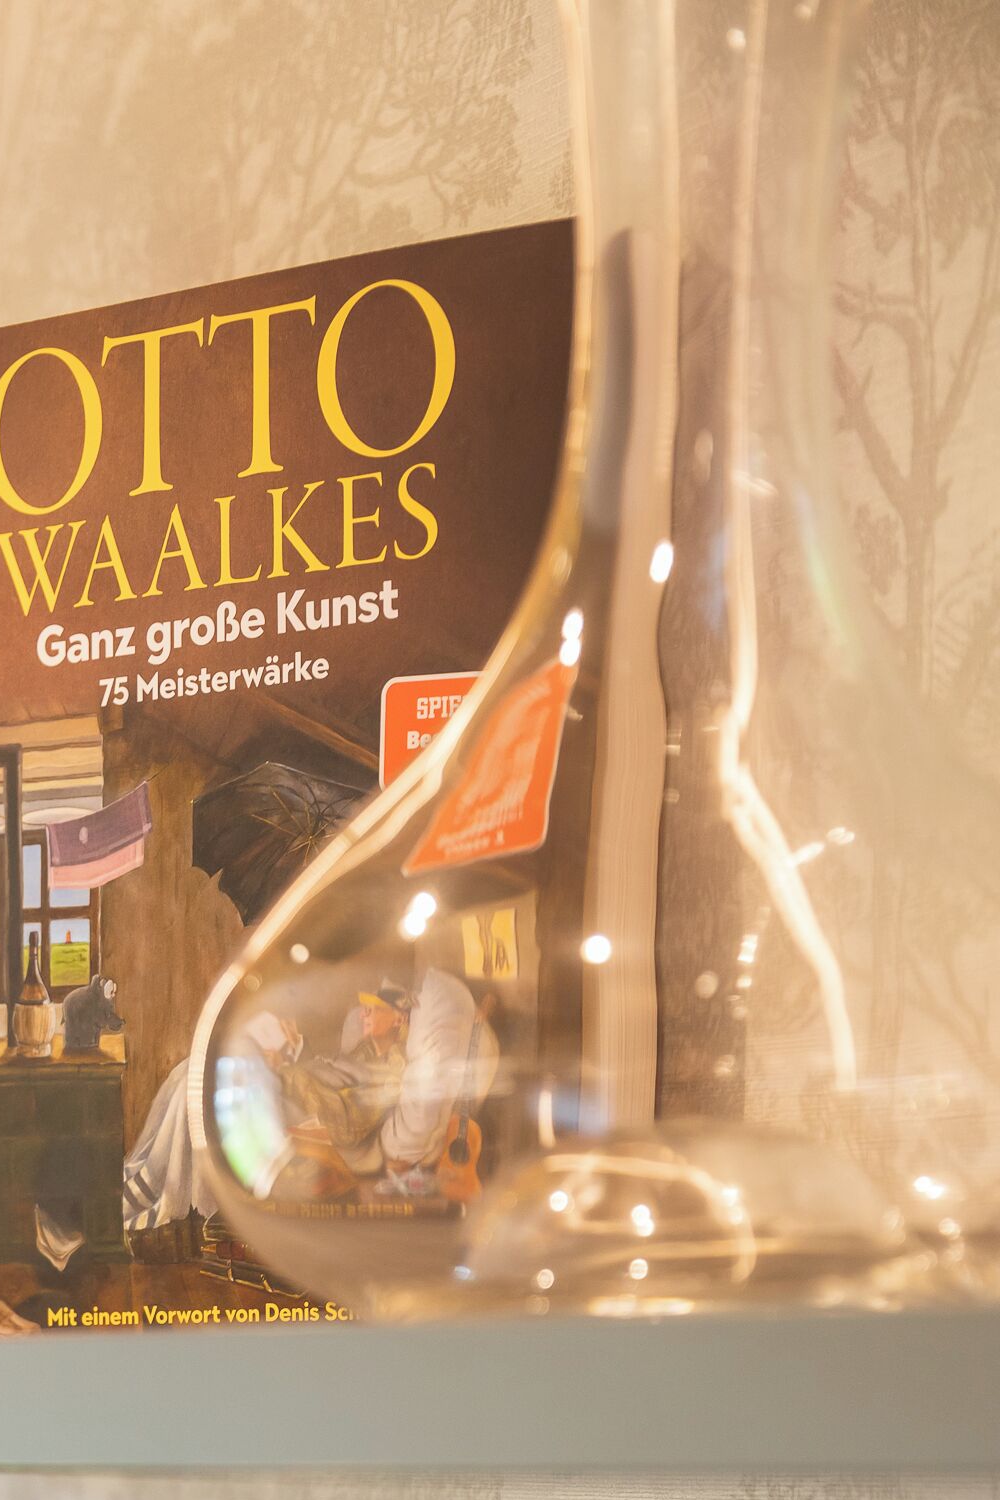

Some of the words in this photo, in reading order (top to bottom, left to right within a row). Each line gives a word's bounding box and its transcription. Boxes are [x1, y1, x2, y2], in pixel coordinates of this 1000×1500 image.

[36, 624, 136, 667] Ganz
[145, 600, 265, 664] große
[276, 579, 399, 634] Kunst
[99, 677, 128, 707] 75
[136, 652, 330, 704] Meisterwärke
[416, 694, 462, 720] SPIE
[47, 1307, 78, 1327] Mit
[81, 1306, 139, 1326] einem
[143, 1305, 221, 1325] Vorwort
[225, 1307, 260, 1324] von
[265, 1302, 319, 1322] Denis
